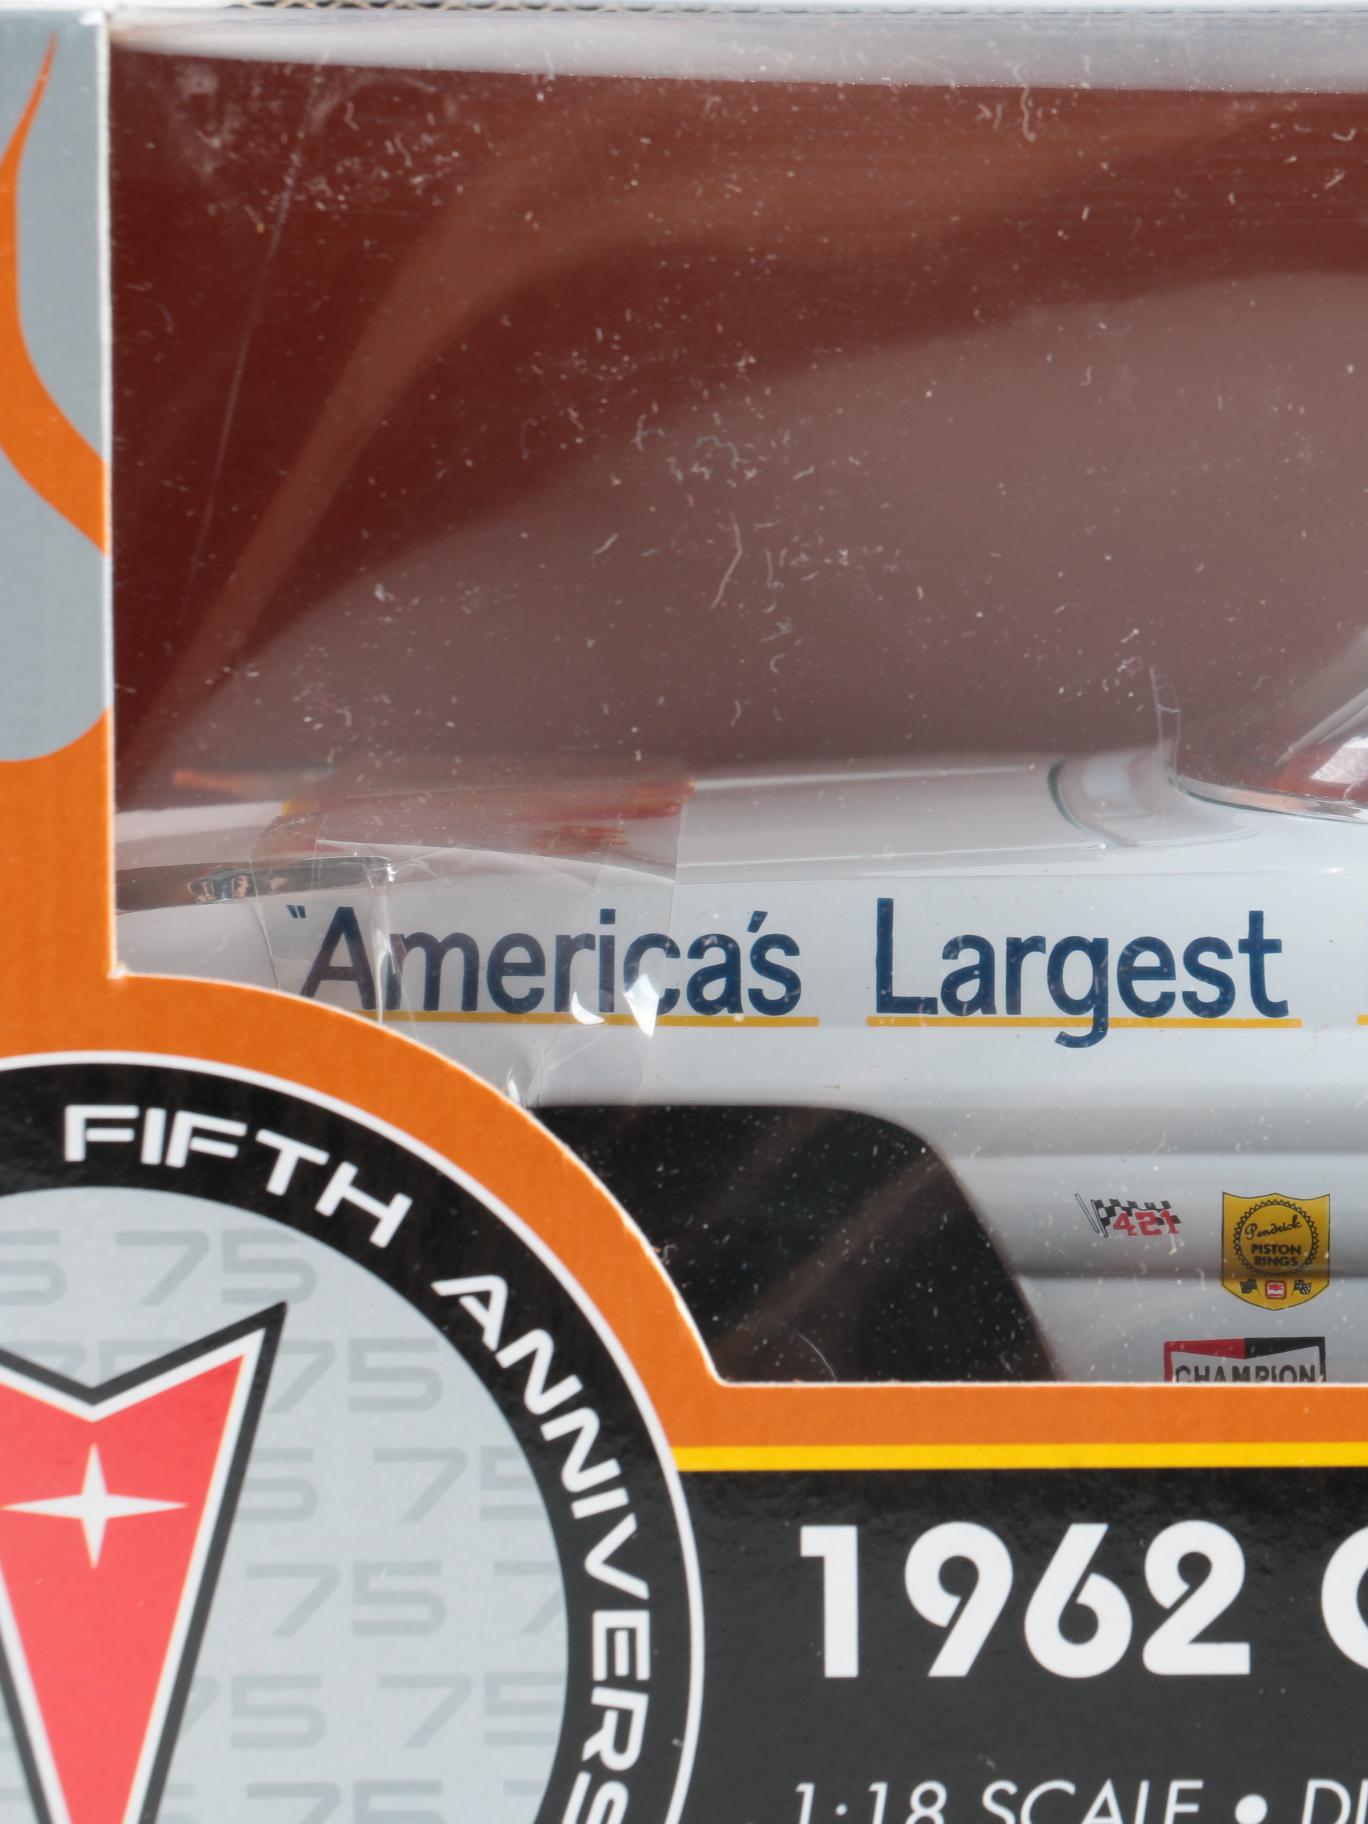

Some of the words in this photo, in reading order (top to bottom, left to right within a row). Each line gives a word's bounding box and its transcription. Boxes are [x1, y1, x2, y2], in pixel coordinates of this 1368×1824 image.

[876, 897, 1290, 1048] Largest
[64, 1104, 413, 1249] FIFTH
[1112, 1210, 1180, 1237] 421
[1251, 1243, 1302, 1255] PISTON
[1254, 1256, 1298, 1266] RINGS
[115, 1229, 319, 1306] 75
[1175, 1364, 1316, 1383] CHAMPION
[246, 1560, 449, 1637] 75
[800, 1520, 1250, 1678] 1962
